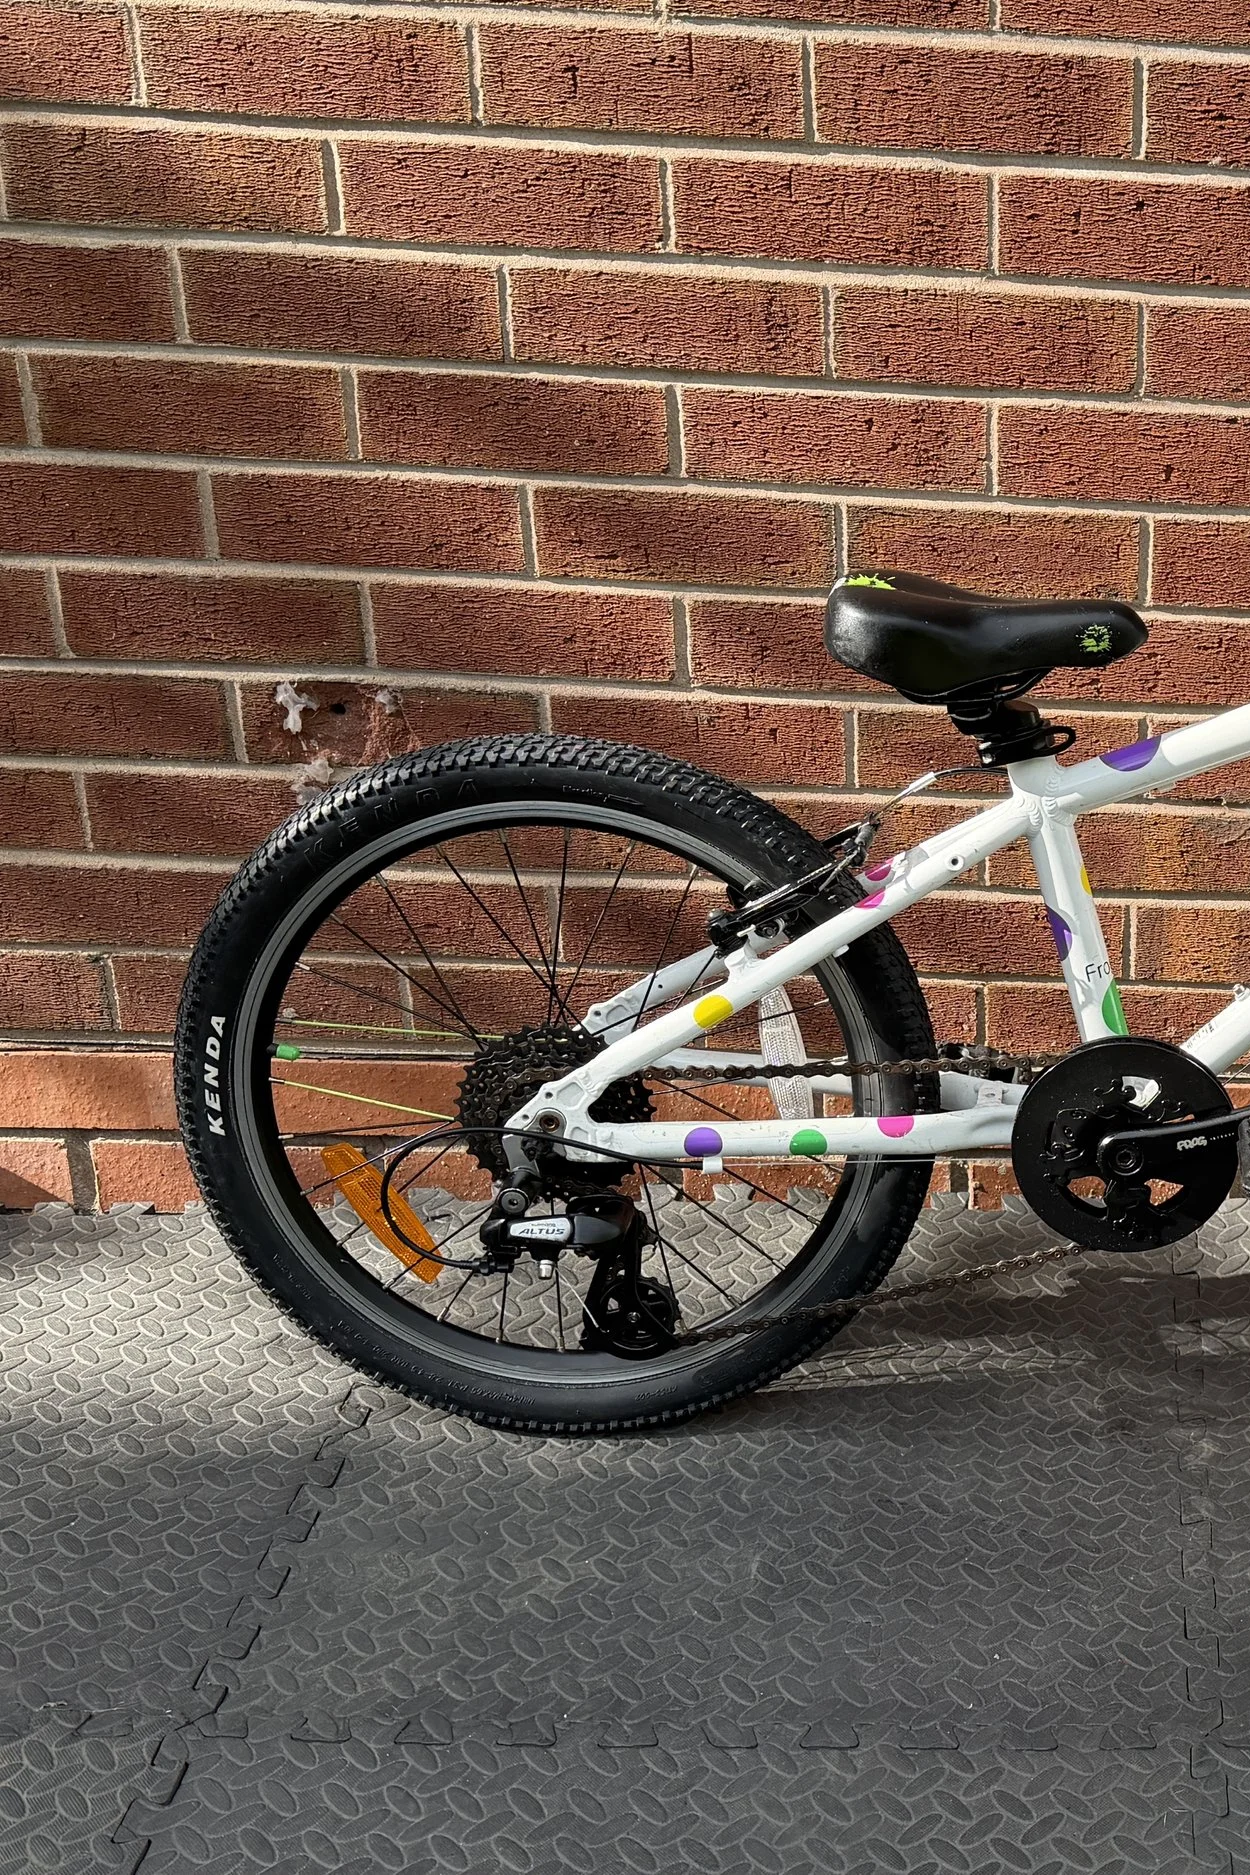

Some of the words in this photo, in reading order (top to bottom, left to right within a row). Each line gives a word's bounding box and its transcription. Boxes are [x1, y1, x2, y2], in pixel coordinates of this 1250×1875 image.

[1085, 961, 1111, 982] Fro
[203, 1015, 226, 1137] KENDA
[1176, 1136, 1208, 1151] FROG
